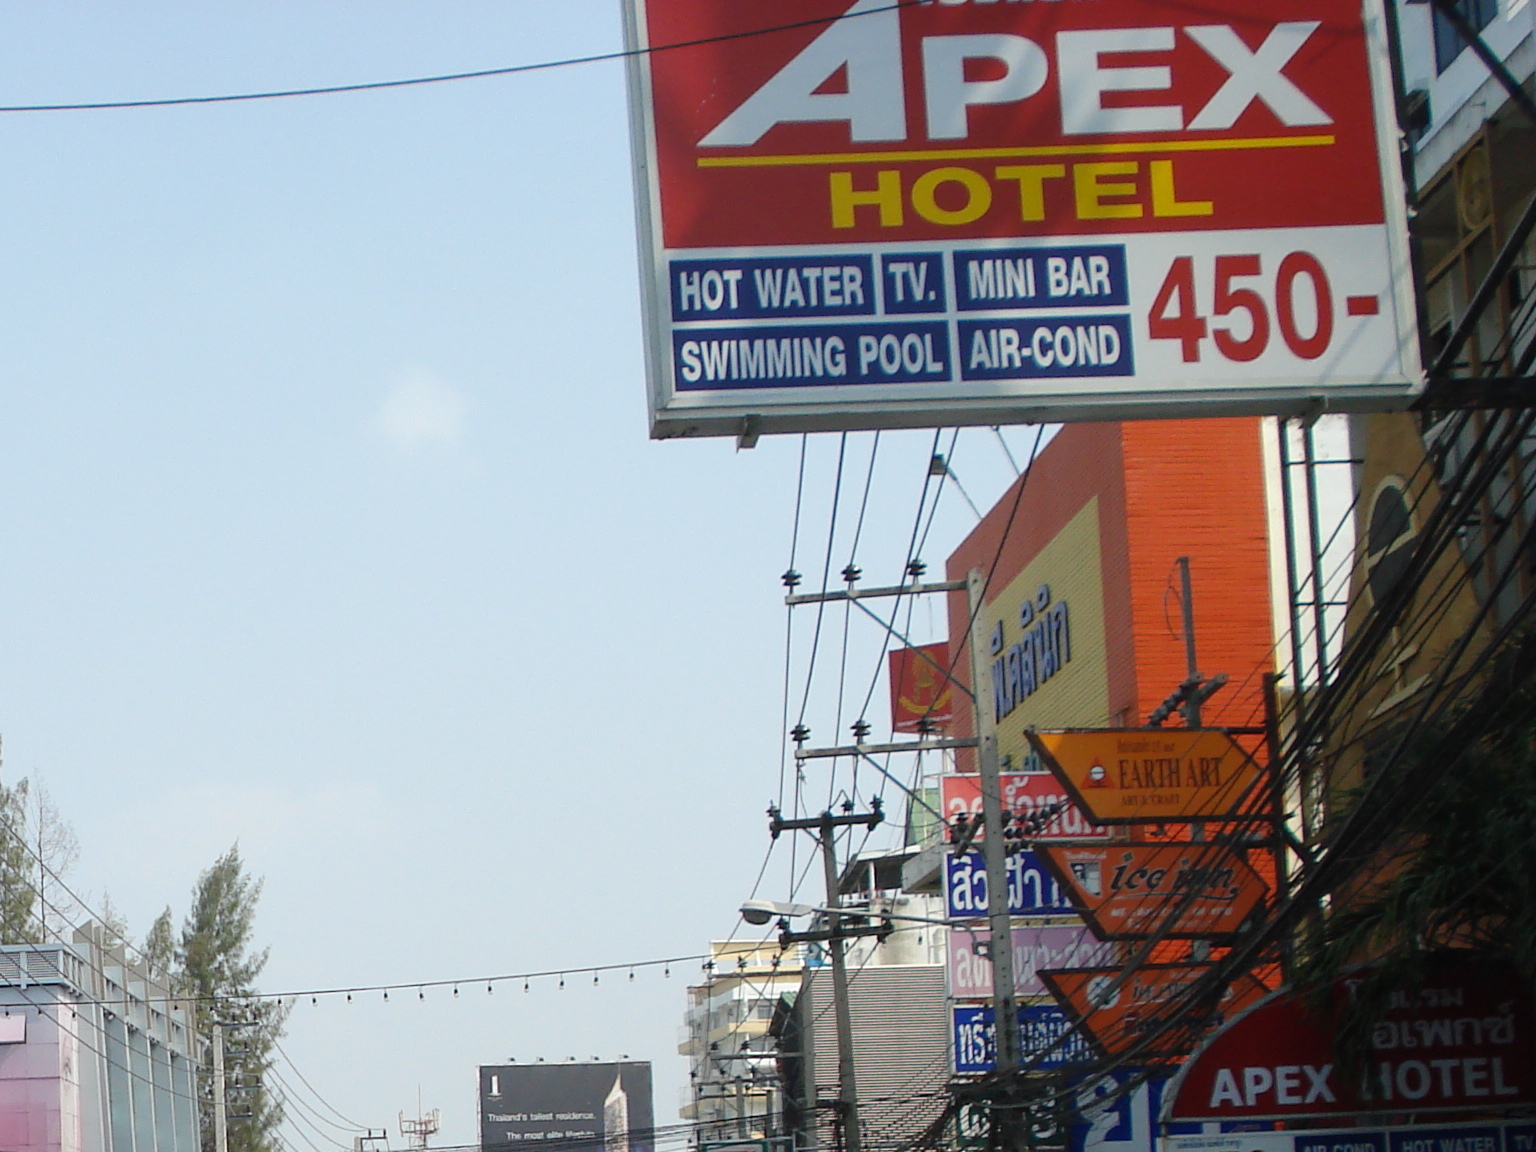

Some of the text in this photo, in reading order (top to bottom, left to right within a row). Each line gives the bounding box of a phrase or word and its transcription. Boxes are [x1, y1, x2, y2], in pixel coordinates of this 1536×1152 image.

[697, 0, 1335, 147] APEX
[830, 160, 1213, 228] HOTEL
[679, 267, 742, 311] HOT
[755, 263, 864, 307] WATER
[889, 261, 936, 303] TV.
[967, 258, 1036, 300] MINI
[1047, 254, 1111, 297] BAR
[680, 324, 1122, 381] SWIMMING POOL AIR-COND
[1119, 757, 1222, 789] EARTH ART
[1210, 1063, 1335, 1108] APEX
[488, 1113, 528, 1122] Thailand's
[530, 1112, 553, 1121] tallest
[507, 1132, 521, 1140] The
[524, 1132, 544, 1140] most
